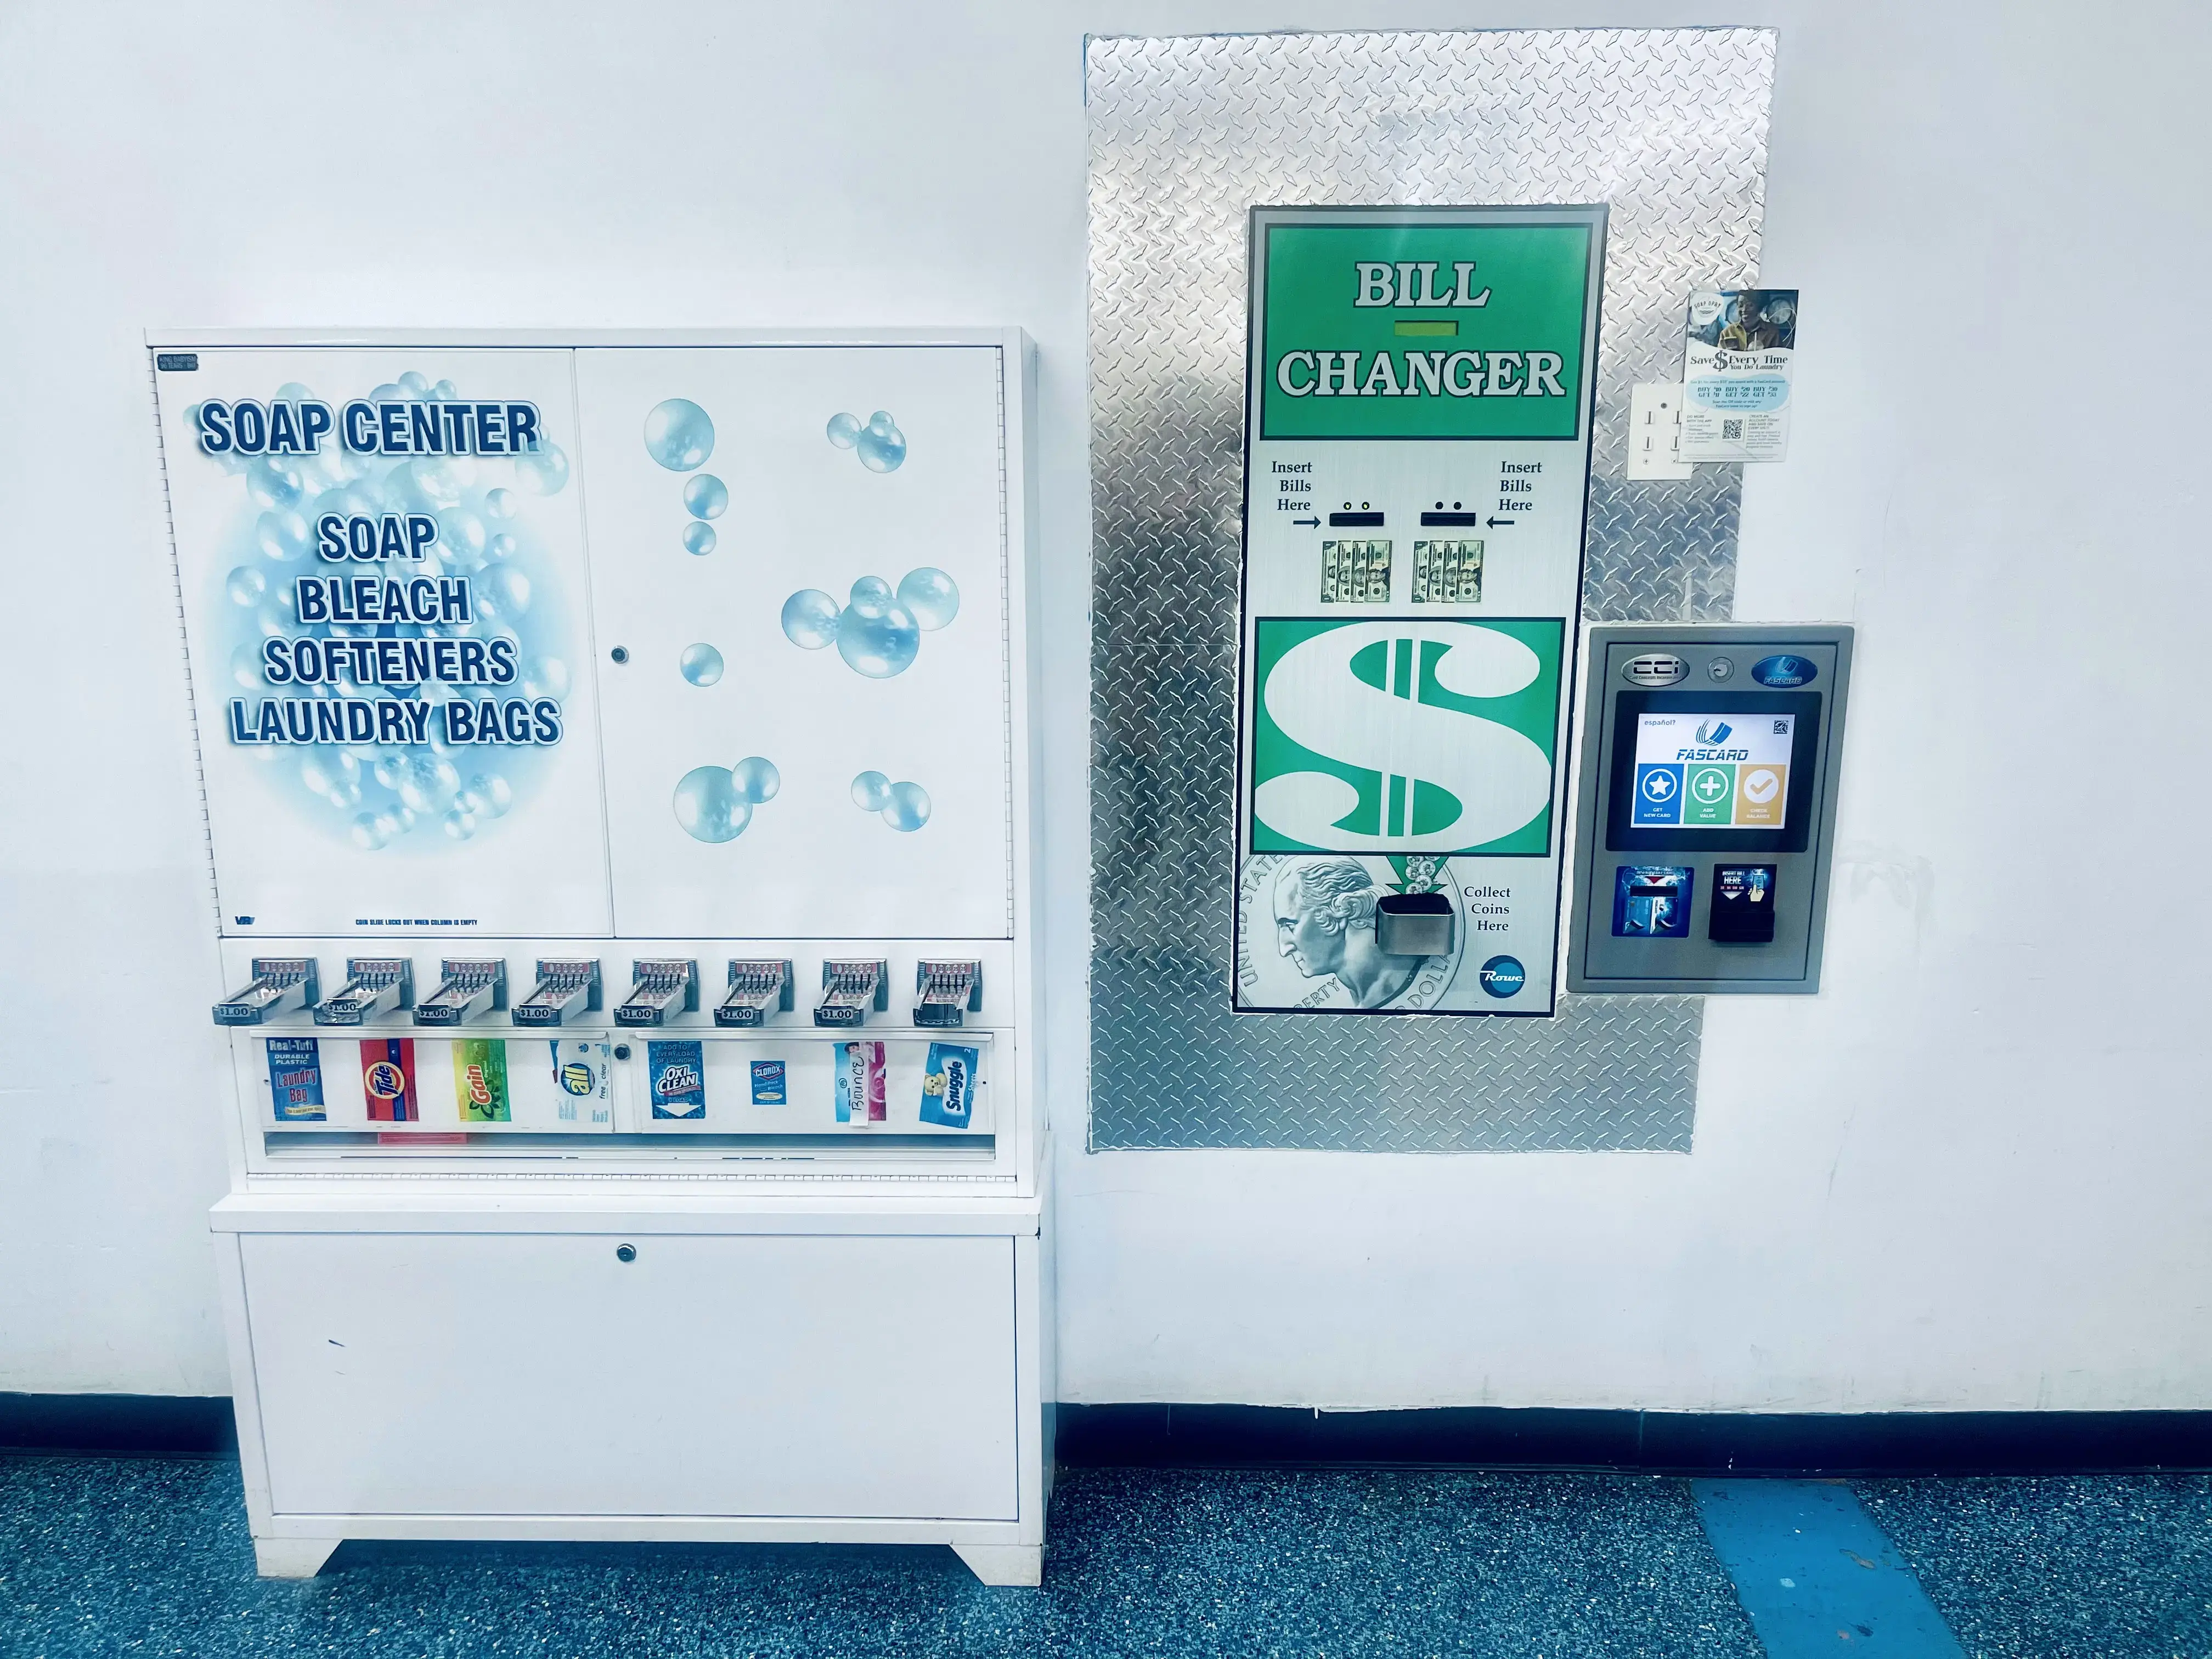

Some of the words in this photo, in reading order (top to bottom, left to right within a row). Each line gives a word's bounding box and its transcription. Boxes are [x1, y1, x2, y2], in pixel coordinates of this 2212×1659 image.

[1353, 261, 1491, 308] BILL
[1729, 356, 1758, 365] Every
[1764, 355, 1787, 364] Time
[1277, 349, 1566, 398] CHANGER
[199, 399, 335, 456] SOAP
[343, 400, 543, 456] CENTER
[1272, 461, 1312, 473] Insert
[1500, 461, 1543, 473] Insert
[1280, 479, 1312, 492] Bills
[1500, 479, 1532, 492] Bills
[1277, 499, 1311, 511] Here
[1499, 499, 1532, 511] Here
[318, 514, 439, 563] SOAP
[296, 575, 473, 623] BLEACH
[263, 636, 518, 685] SOFTENERS
[230, 697, 435, 744] LAUNDRY
[445, 697, 563, 746] BAGS
[1676, 749, 1749, 761] FASCARD
[1240, 855, 1288, 904] STATE
[1724, 876, 1741, 884] HERE
[1464, 887, 1511, 898] Collect
[1471, 904, 1509, 914] Coins
[1477, 920, 1509, 931] Here
[1238, 911, 1258, 987] UNITED
[1407, 955, 1450, 1009] DOLLA
[1480, 970, 1524, 981] Rowe
[220, 1007, 249, 1016] $1.00
[329, 1003, 356, 1012] $1.00
[521, 1009, 549, 1018] $1.00
[623, 1009, 651, 1018] $1.00
[723, 1009, 752, 1019] $1.00
[823, 1009, 851, 1019] $1.00
[665, 1066, 688, 1080] OXI
[755, 1065, 780, 1077] CLOROX
[276, 1068, 317, 1088] Laundry
[375, 1065, 399, 1095] Tide
[467, 1065, 492, 1104] Gain
[563, 1065, 590, 1094] all
[658, 1074, 696, 1093] CLEAN
[946, 1061, 964, 1111] Snuggle
[289, 1088, 308, 1103] Bag
